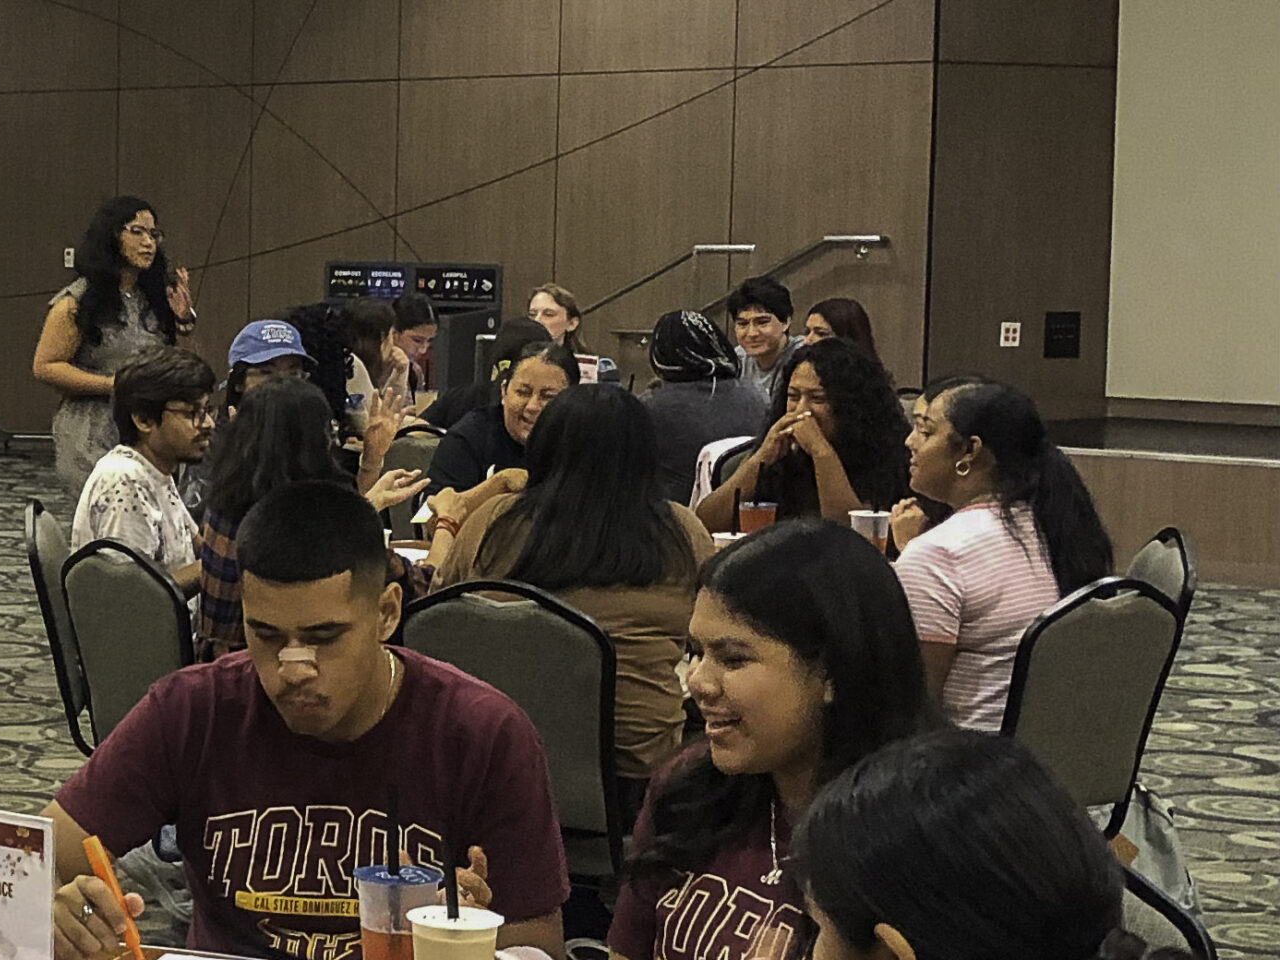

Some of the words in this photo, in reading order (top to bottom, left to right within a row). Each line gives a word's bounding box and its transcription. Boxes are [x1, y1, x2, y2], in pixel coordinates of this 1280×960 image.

[203, 805, 445, 898] TOROS
[254, 896, 271, 909] CAL
[273, 896, 300, 912] STATE
[302, 898, 351, 915] DOMINGUEZ
